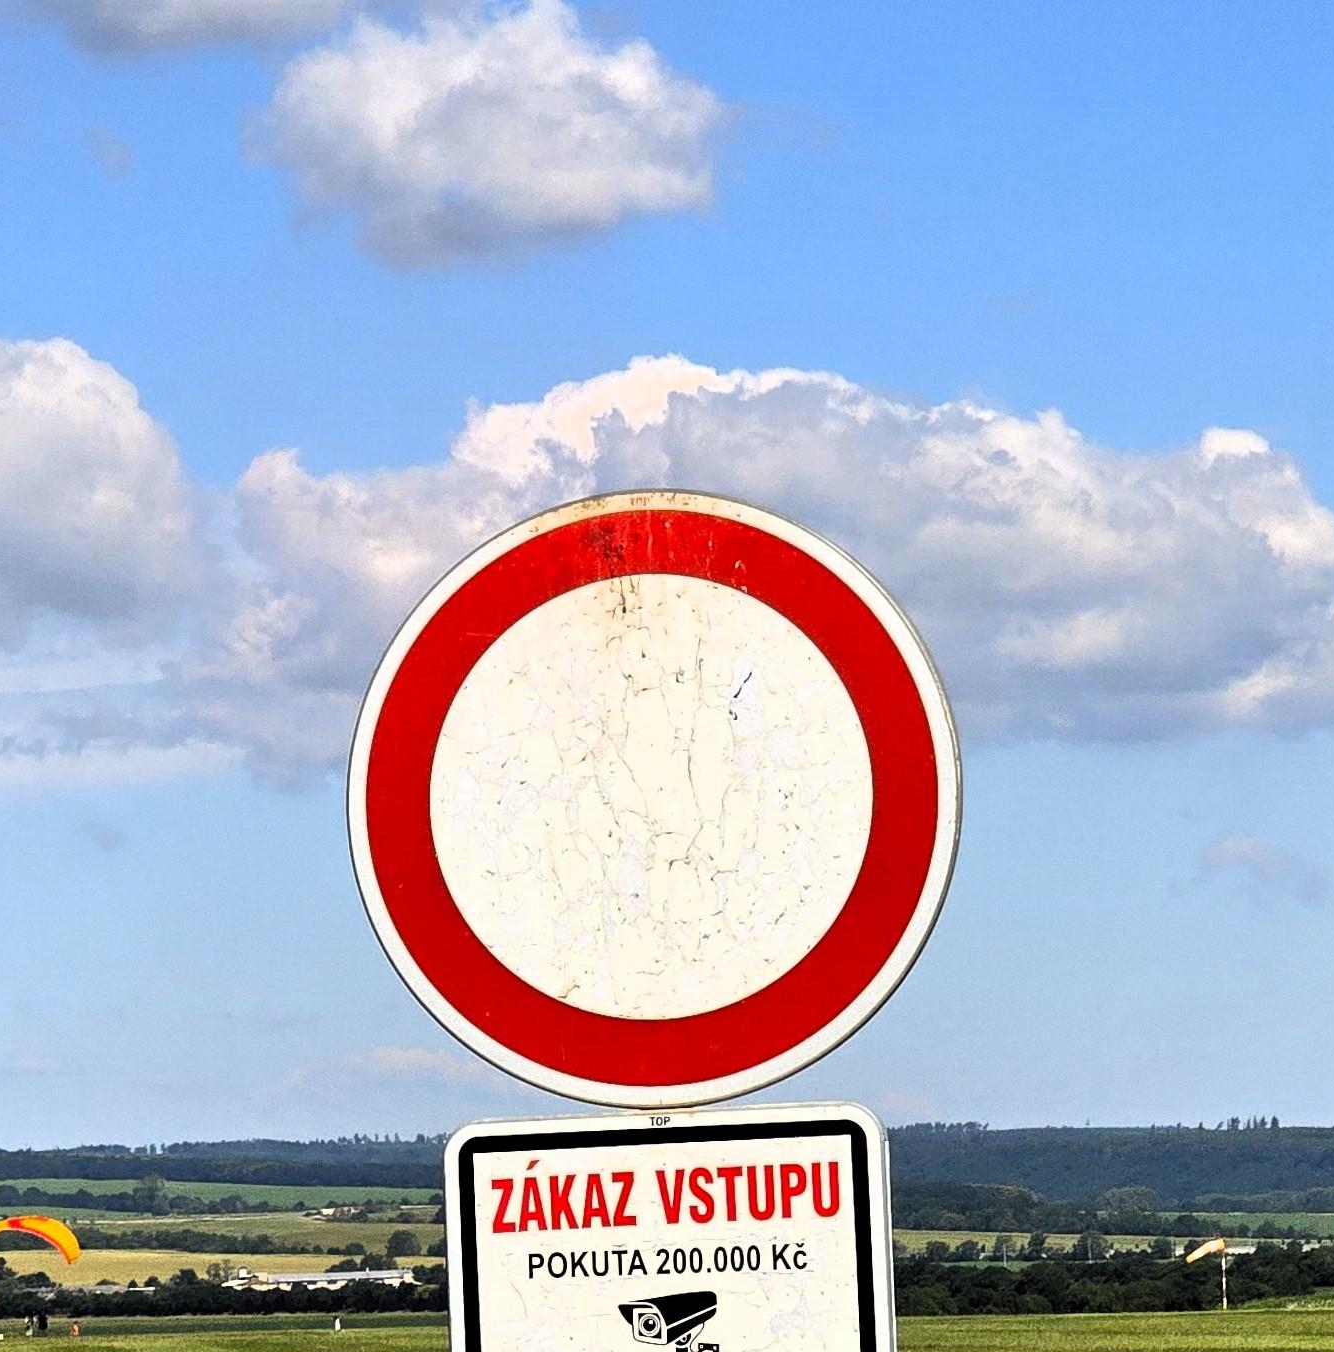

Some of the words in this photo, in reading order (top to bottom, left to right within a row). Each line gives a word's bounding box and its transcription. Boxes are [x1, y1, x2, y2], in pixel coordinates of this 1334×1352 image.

[649, 1116, 671, 1127] TOP
[490, 1159, 638, 1233] ZÁKAZ
[655, 1161, 841, 1225] VSTUPU
[527, 1249, 648, 1280] POKUTA
[655, 1244, 762, 1275] 200.000
[771, 1242, 808, 1271] Kč
